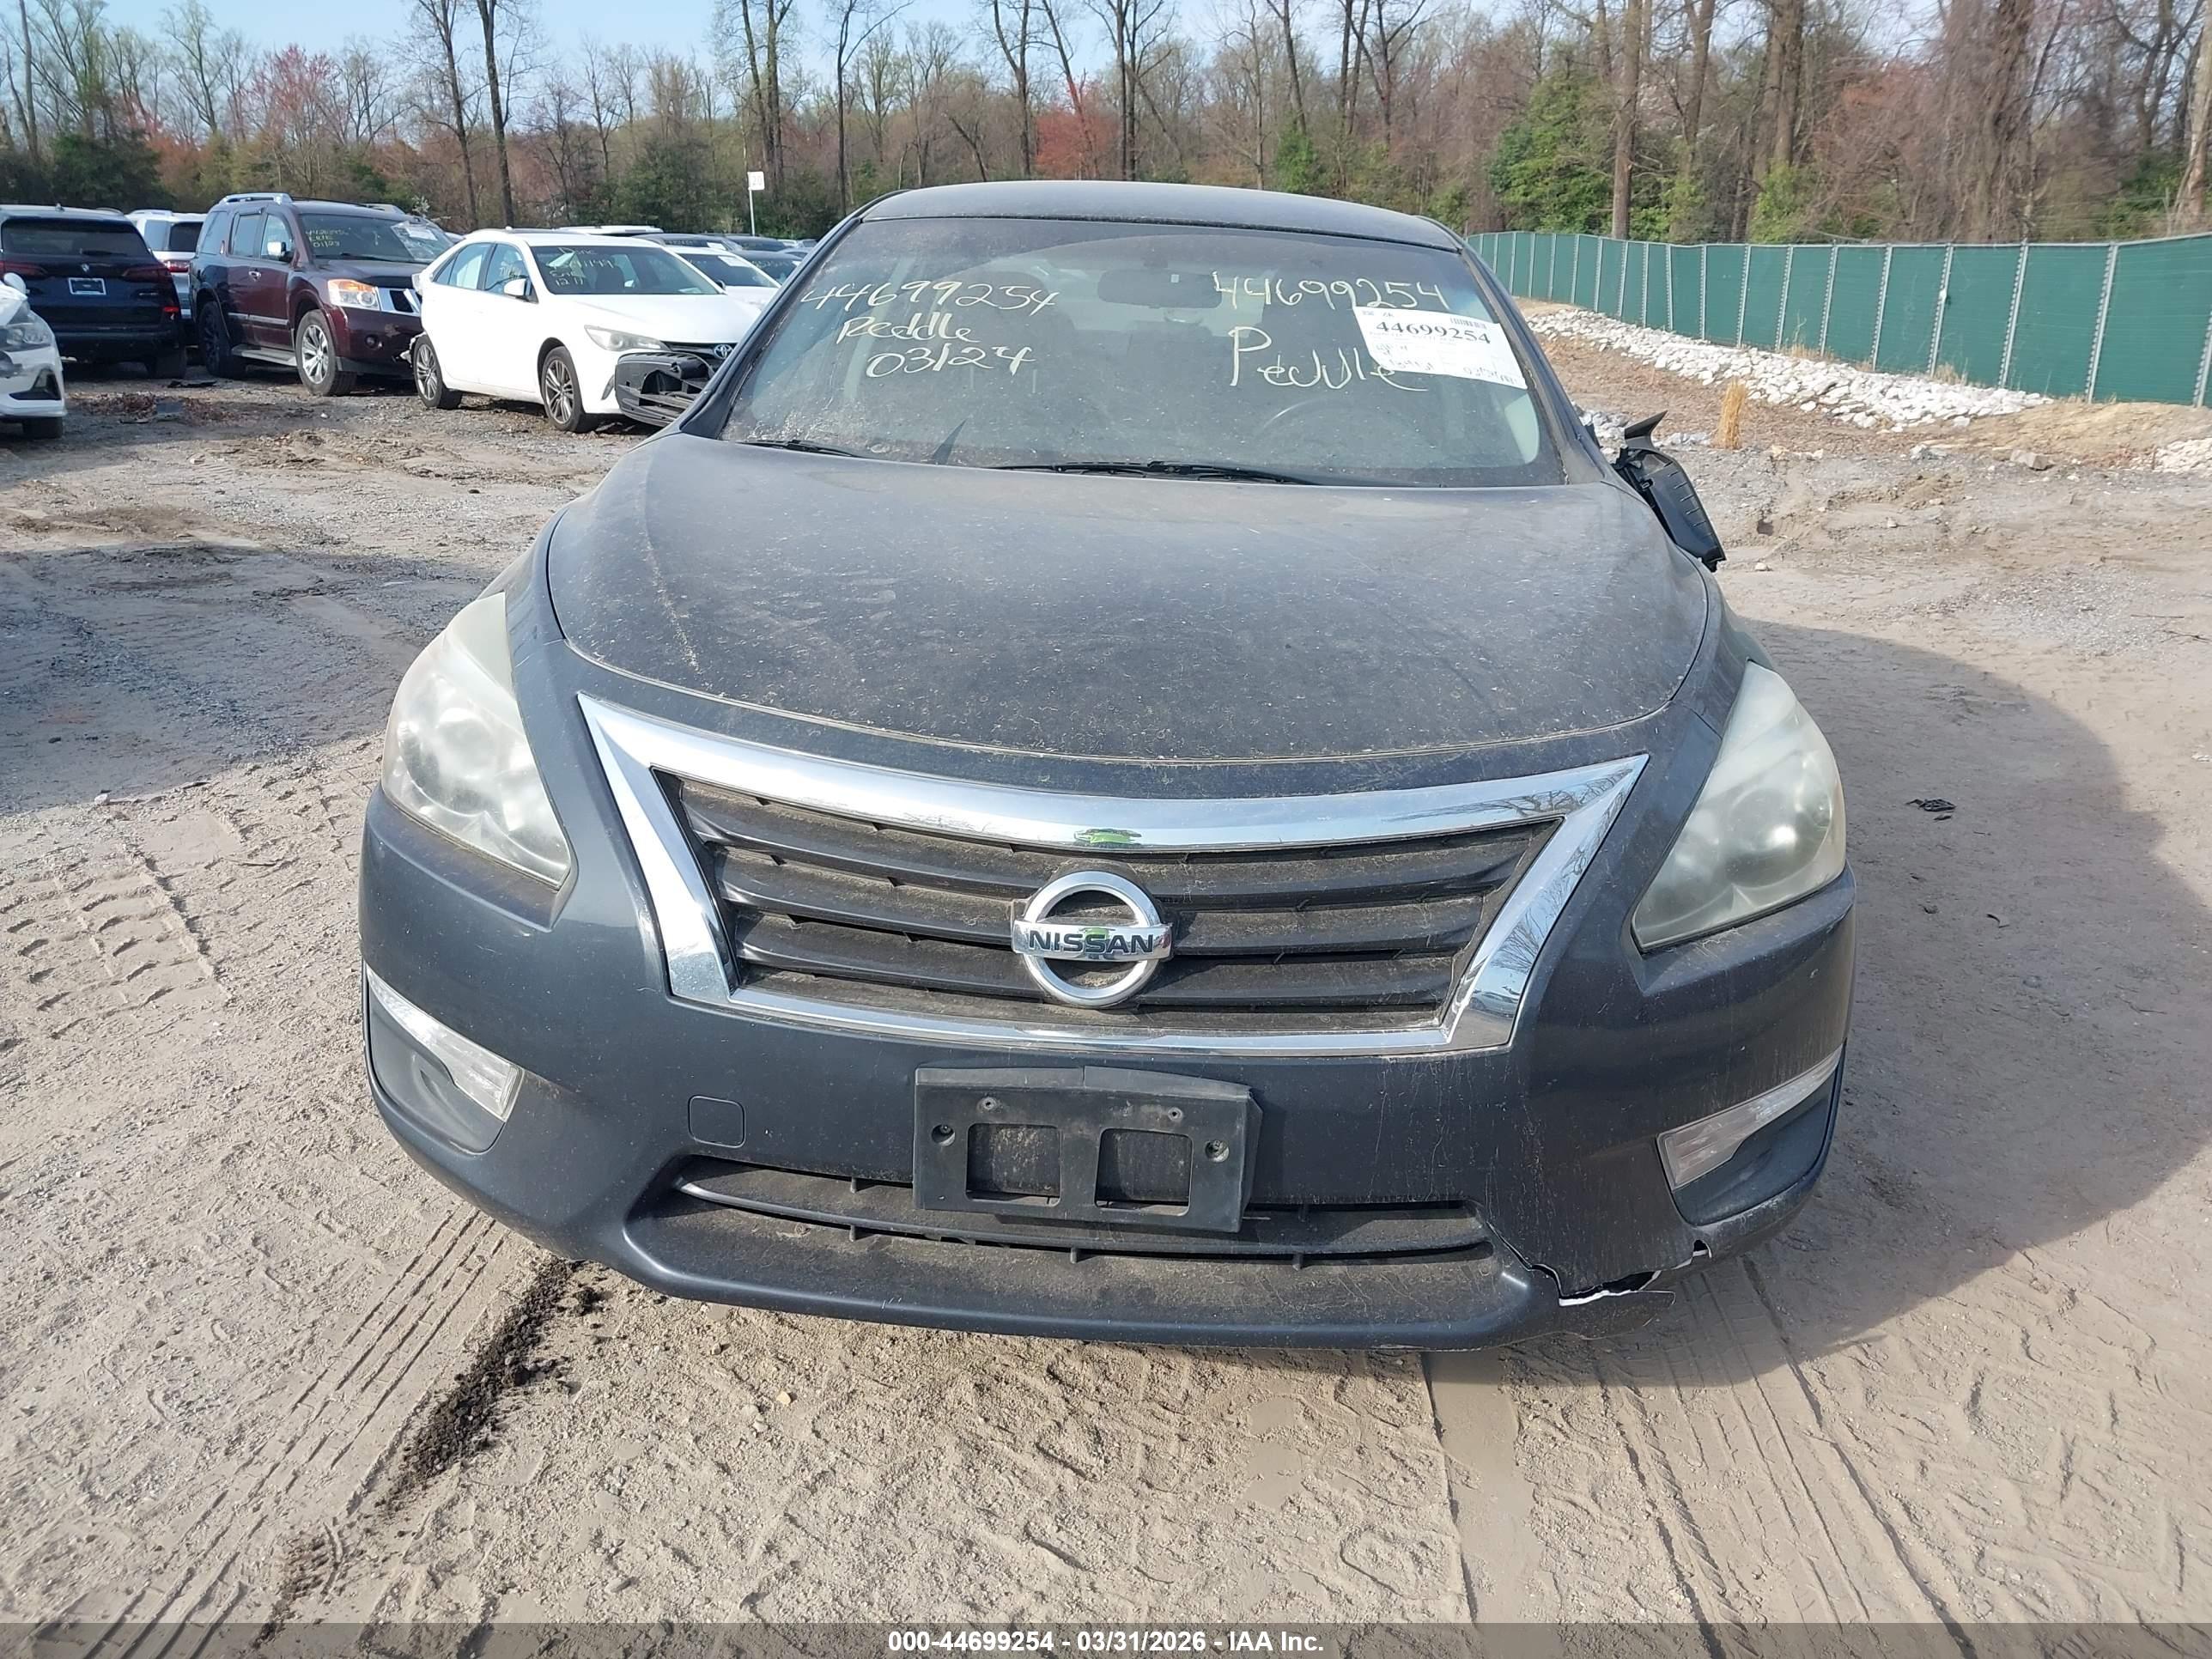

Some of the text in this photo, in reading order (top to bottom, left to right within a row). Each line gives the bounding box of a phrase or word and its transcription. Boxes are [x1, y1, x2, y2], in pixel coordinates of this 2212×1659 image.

[800, 280, 1060, 316] 44699254
[1212, 271, 1450, 310] 44699254
[1376, 321, 1491, 344] 44699254
[1030, 930, 1154, 954] NISSAN
